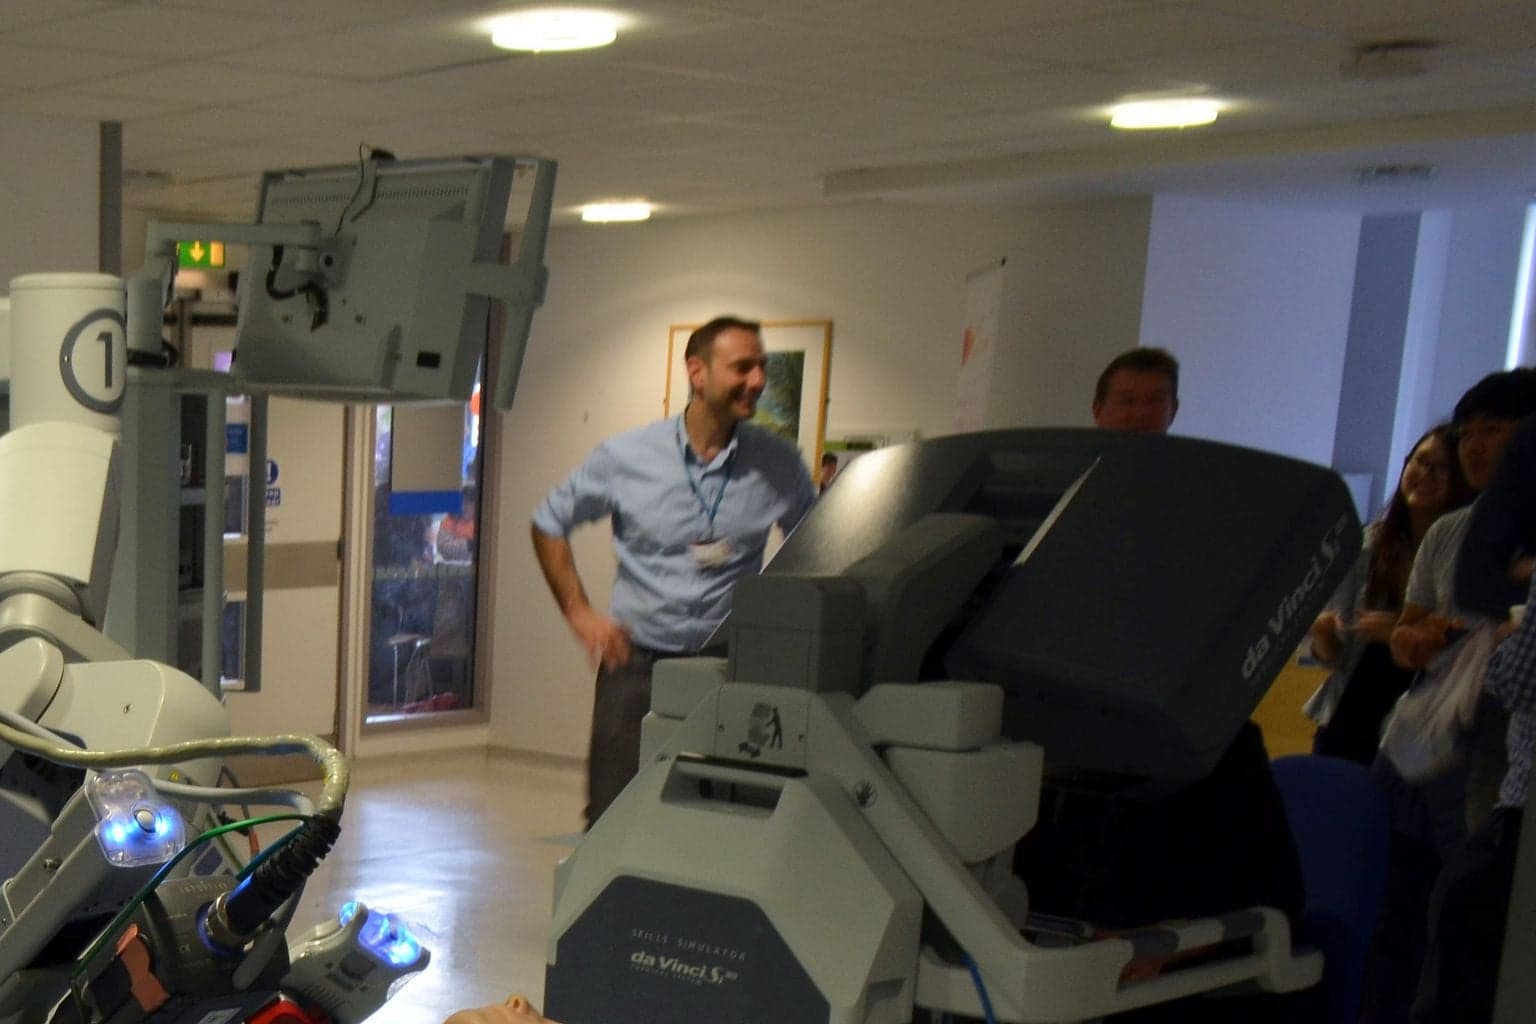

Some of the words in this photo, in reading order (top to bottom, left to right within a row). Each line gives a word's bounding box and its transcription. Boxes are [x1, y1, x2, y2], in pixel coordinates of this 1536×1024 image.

[97, 331, 113, 389] 1
[631, 951, 656, 966] da
[659, 956, 708, 979] Vinci
